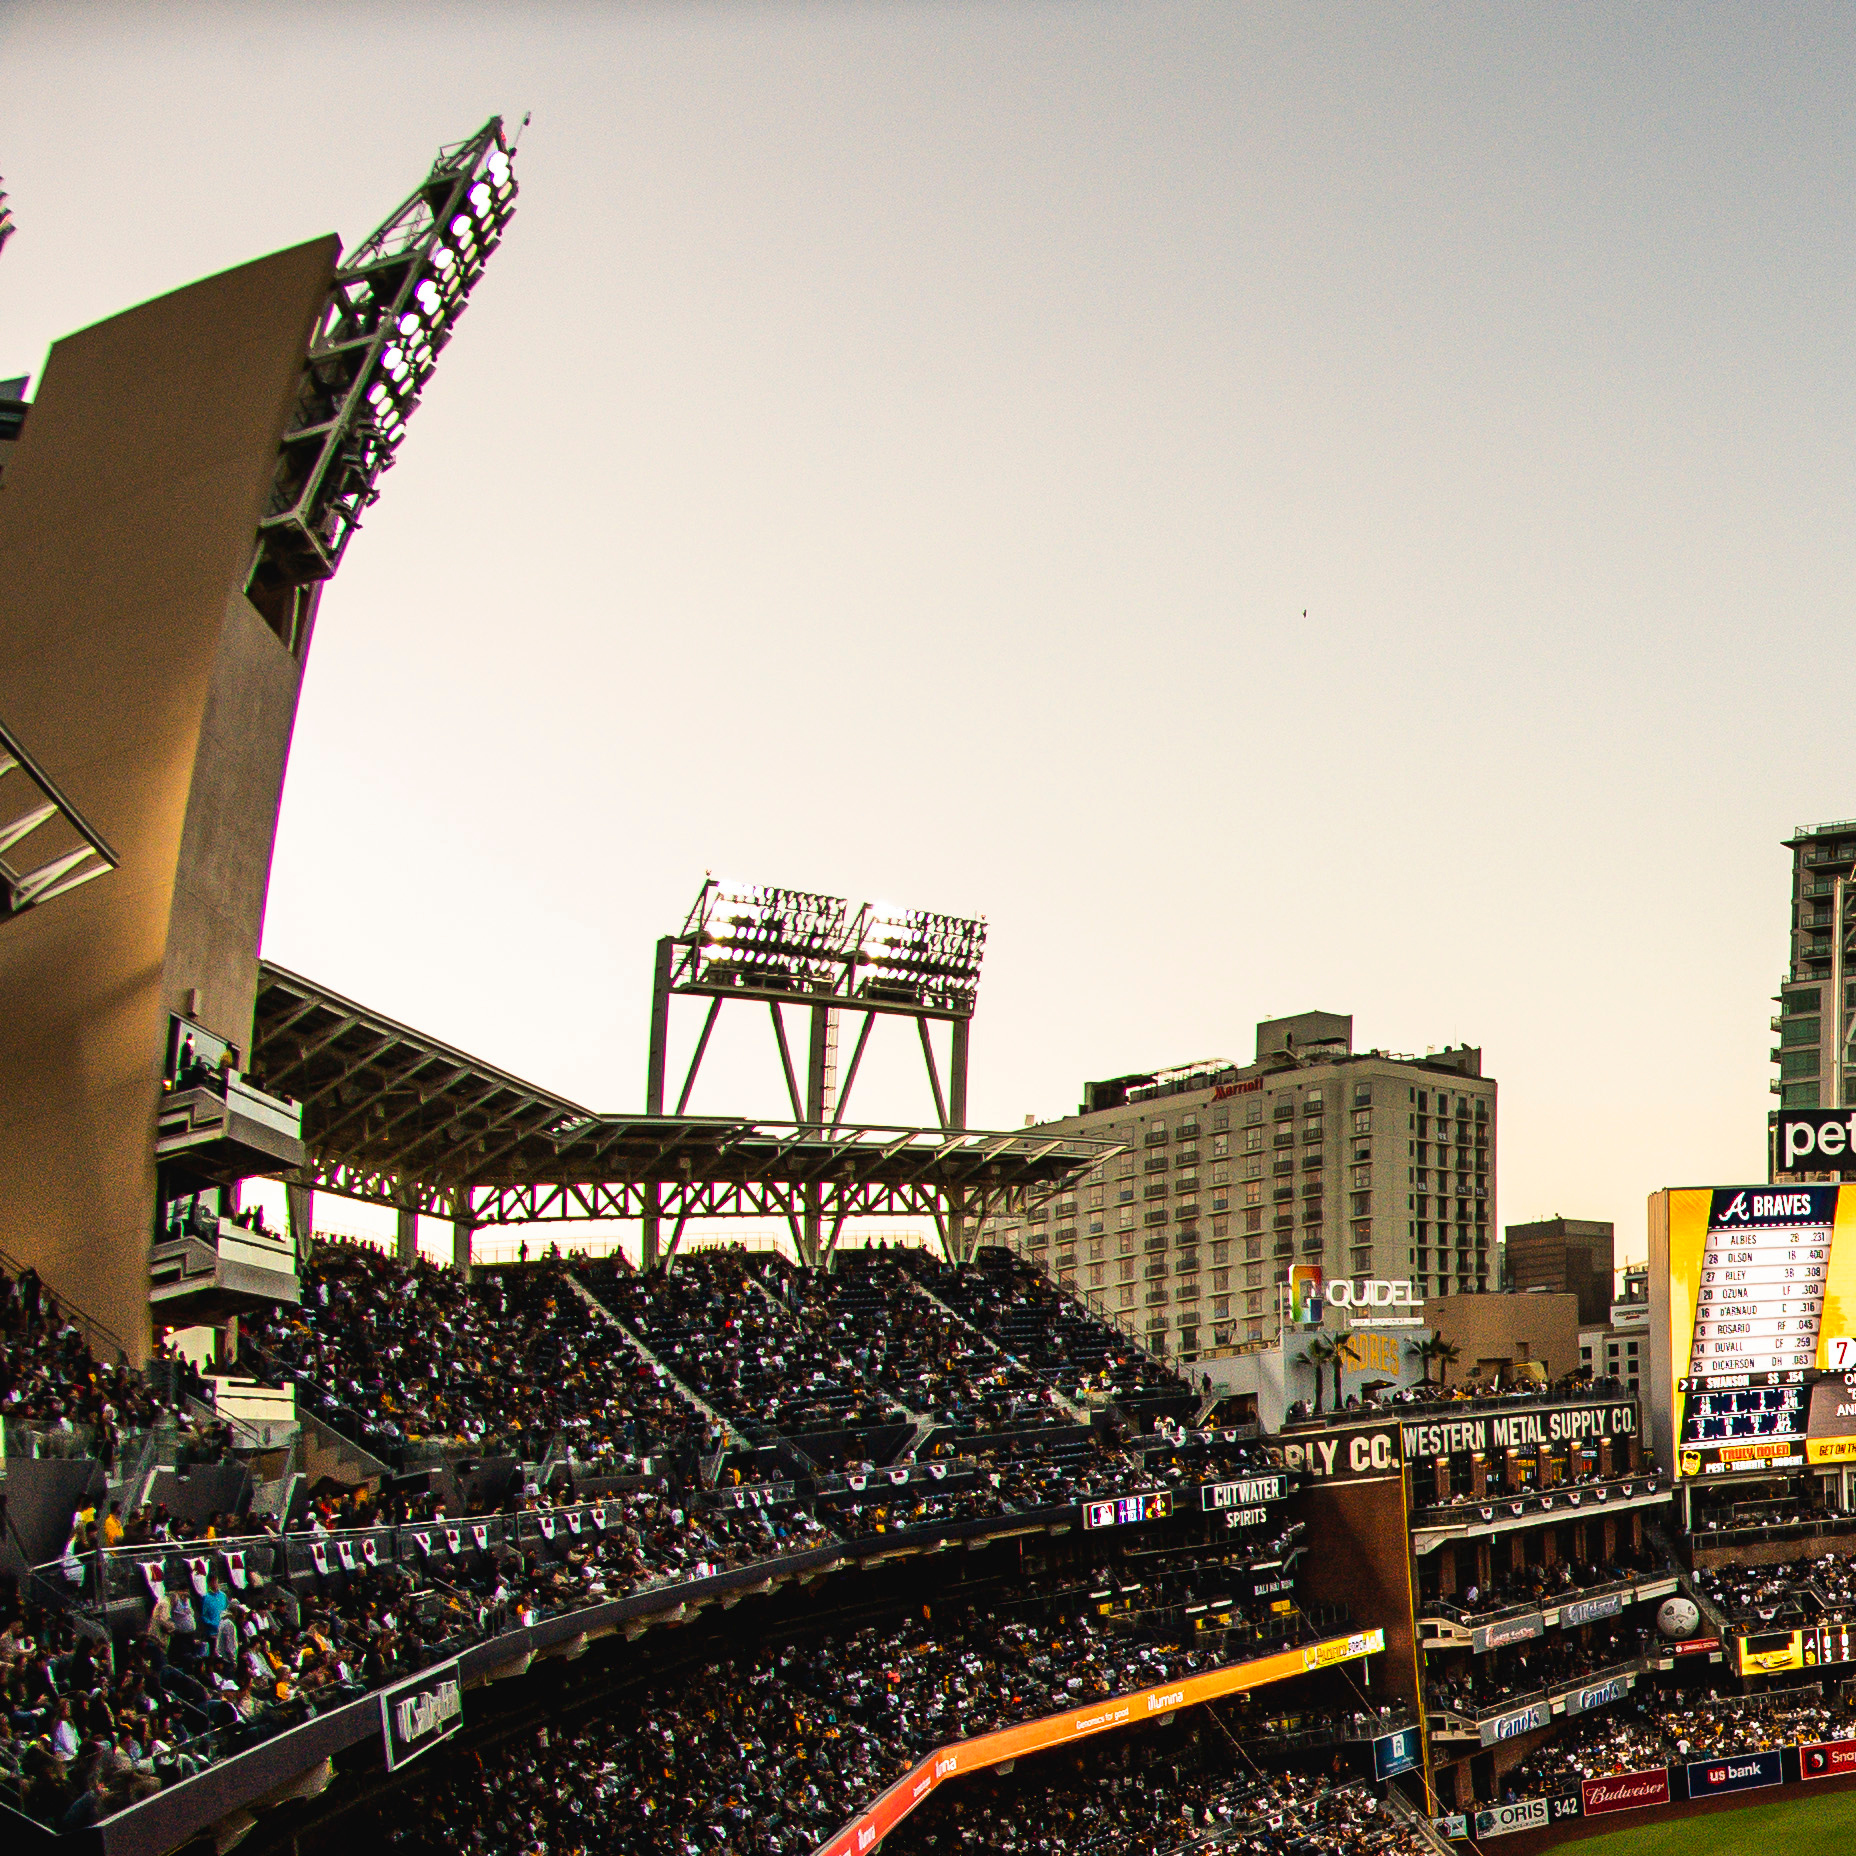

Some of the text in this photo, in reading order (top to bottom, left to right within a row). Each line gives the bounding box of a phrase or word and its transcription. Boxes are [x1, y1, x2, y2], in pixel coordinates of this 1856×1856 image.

[1754, 1194, 1811, 1216] BRAVES
[1714, 1232, 1824, 1246] 1 ALBIES 2B .231
[1708, 1250, 1823, 1264] 28 OLSON 1B .400
[1706, 1267, 1820, 1282] 27 RILEY 3B .308
[1327, 1280, 1424, 1309] QUIDEL
[1704, 1284, 1818, 1300] 20 OZUNA LF .300
[1700, 1320, 1813, 1336] 8 ROSARIO RF .045
[1696, 1344, 1704, 1354] 14
[1715, 1342, 1742, 1352] DUVALL
[1775, 1339, 1783, 1348] CF
[1837, 1342, 1847, 1364] 7
[1692, 1379, 1698, 1390] 7
[1707, 1375, 1749, 1388] SWANSON
[1767, 1373, 1779, 1384] SS
[1403, 1407, 1635, 1457] WESTERN METAL SUPPLY CO.
[1350, 1434, 1400, 1471] CO.
[1214, 1479, 1279, 1507] CUTWATER
[1226, 1508, 1266, 1528] SPIRITS
[1148, 1690, 1184, 1711] illumina
[1709, 1764, 1761, 1781] us bank
[1586, 1782, 1664, 1804] Budweiser
[1501, 1802, 1545, 1826] ORIS
[1554, 1798, 1577, 1818] 342
